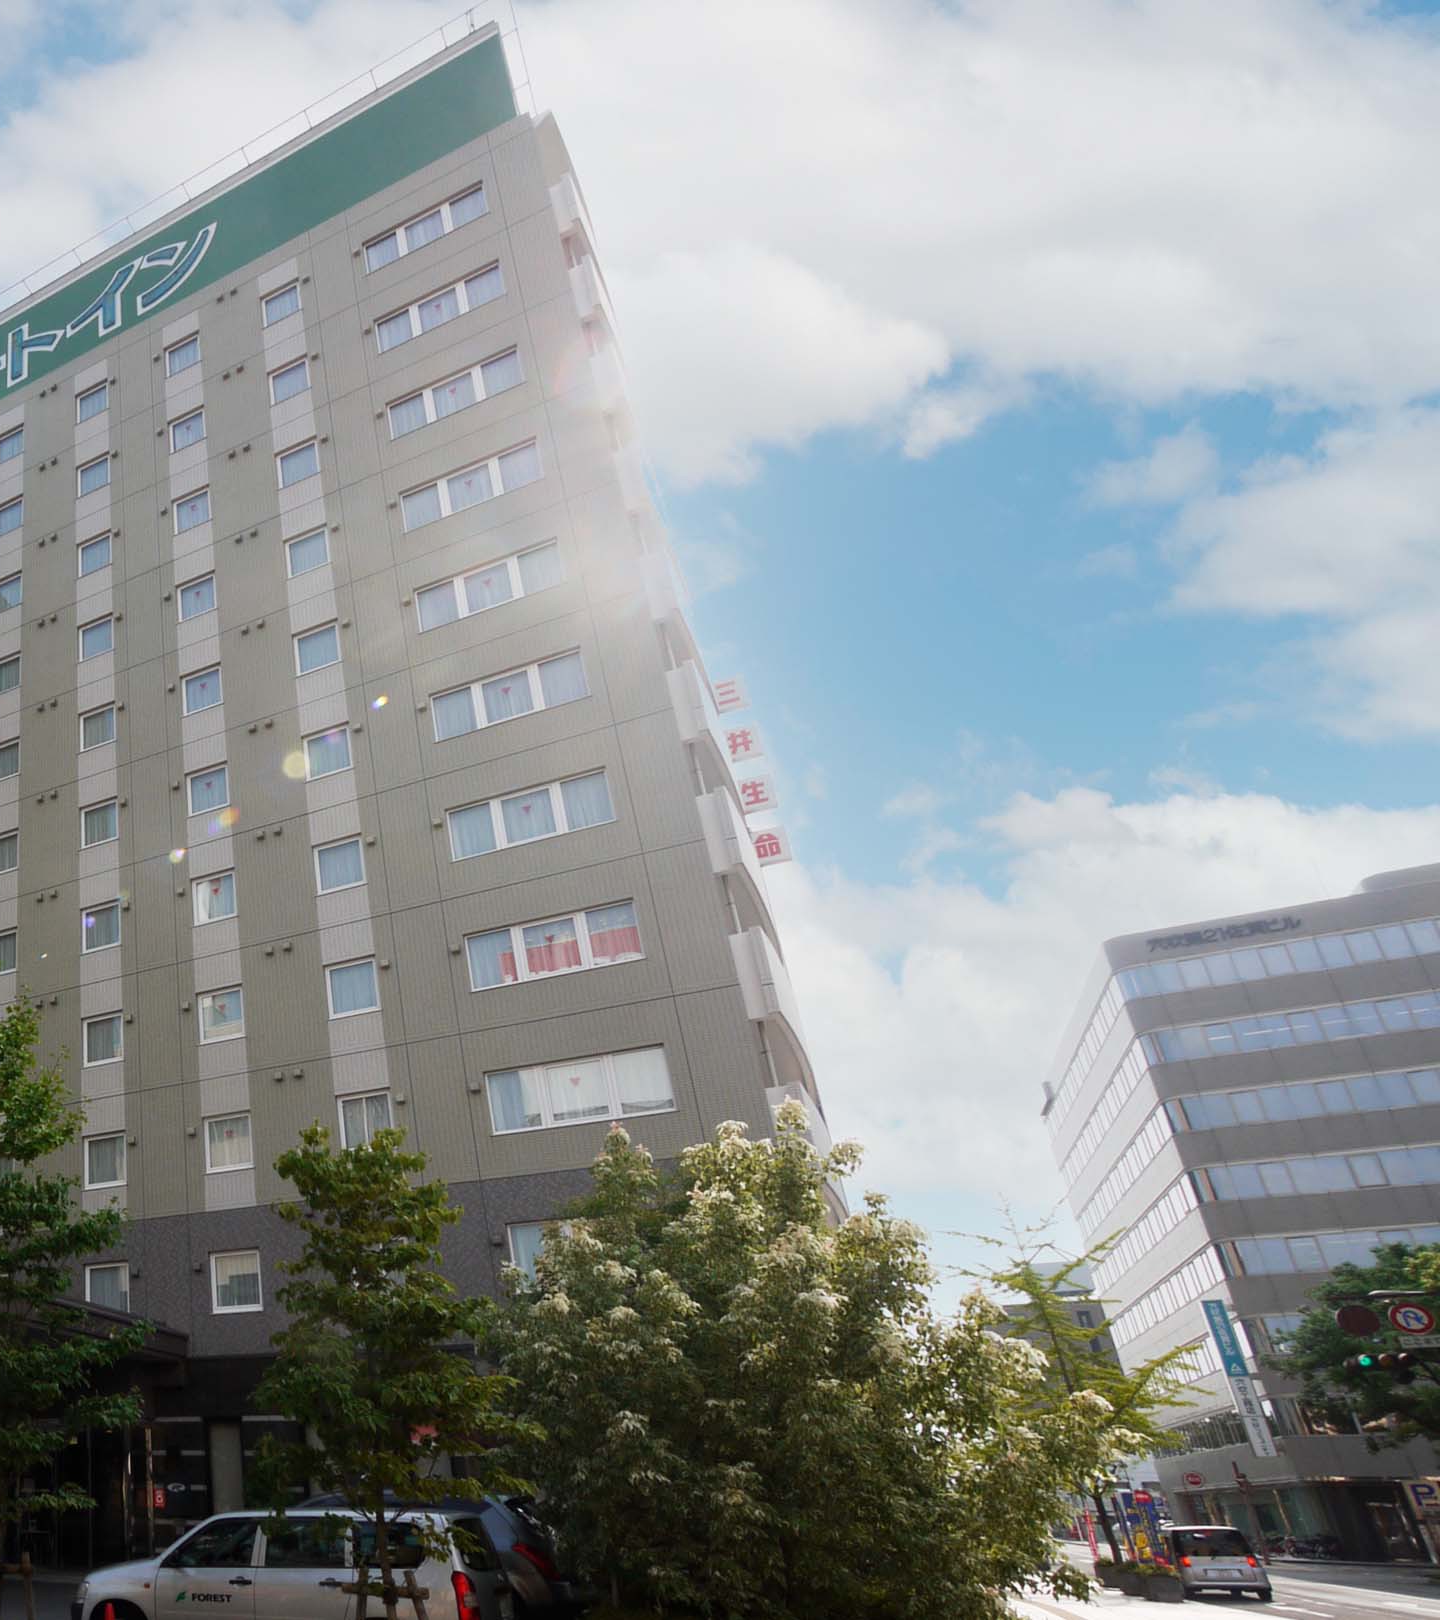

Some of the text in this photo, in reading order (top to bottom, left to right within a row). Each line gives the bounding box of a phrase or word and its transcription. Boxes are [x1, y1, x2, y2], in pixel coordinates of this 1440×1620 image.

[715, 680, 782, 859] 三井生命
[1408, 1484, 1436, 1506] P
[191, 1593, 233, 1603] FOREST
